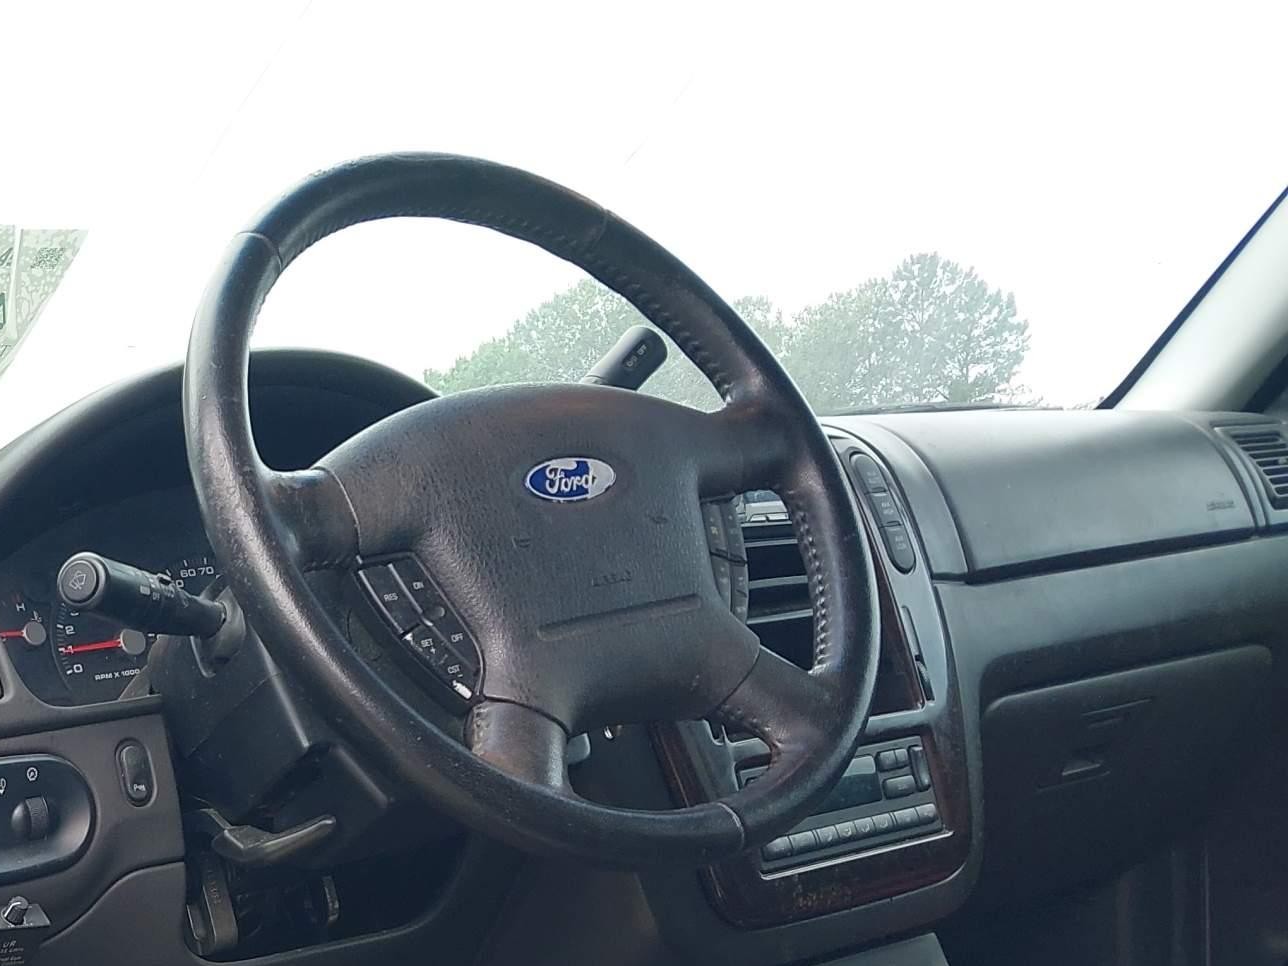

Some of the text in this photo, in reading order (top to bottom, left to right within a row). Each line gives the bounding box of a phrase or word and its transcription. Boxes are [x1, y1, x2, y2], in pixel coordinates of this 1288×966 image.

[545, 467, 597, 494] Ford
[180, 566, 215, 578] 60 70
[383, 592, 398, 602] RES
[64, 625, 75, 635] 2
[450, 632, 464, 643] OFF
[420, 638, 434, 648] SET
[73, 663, 83, 673] 0
[94, 673, 113, 681] RPM
